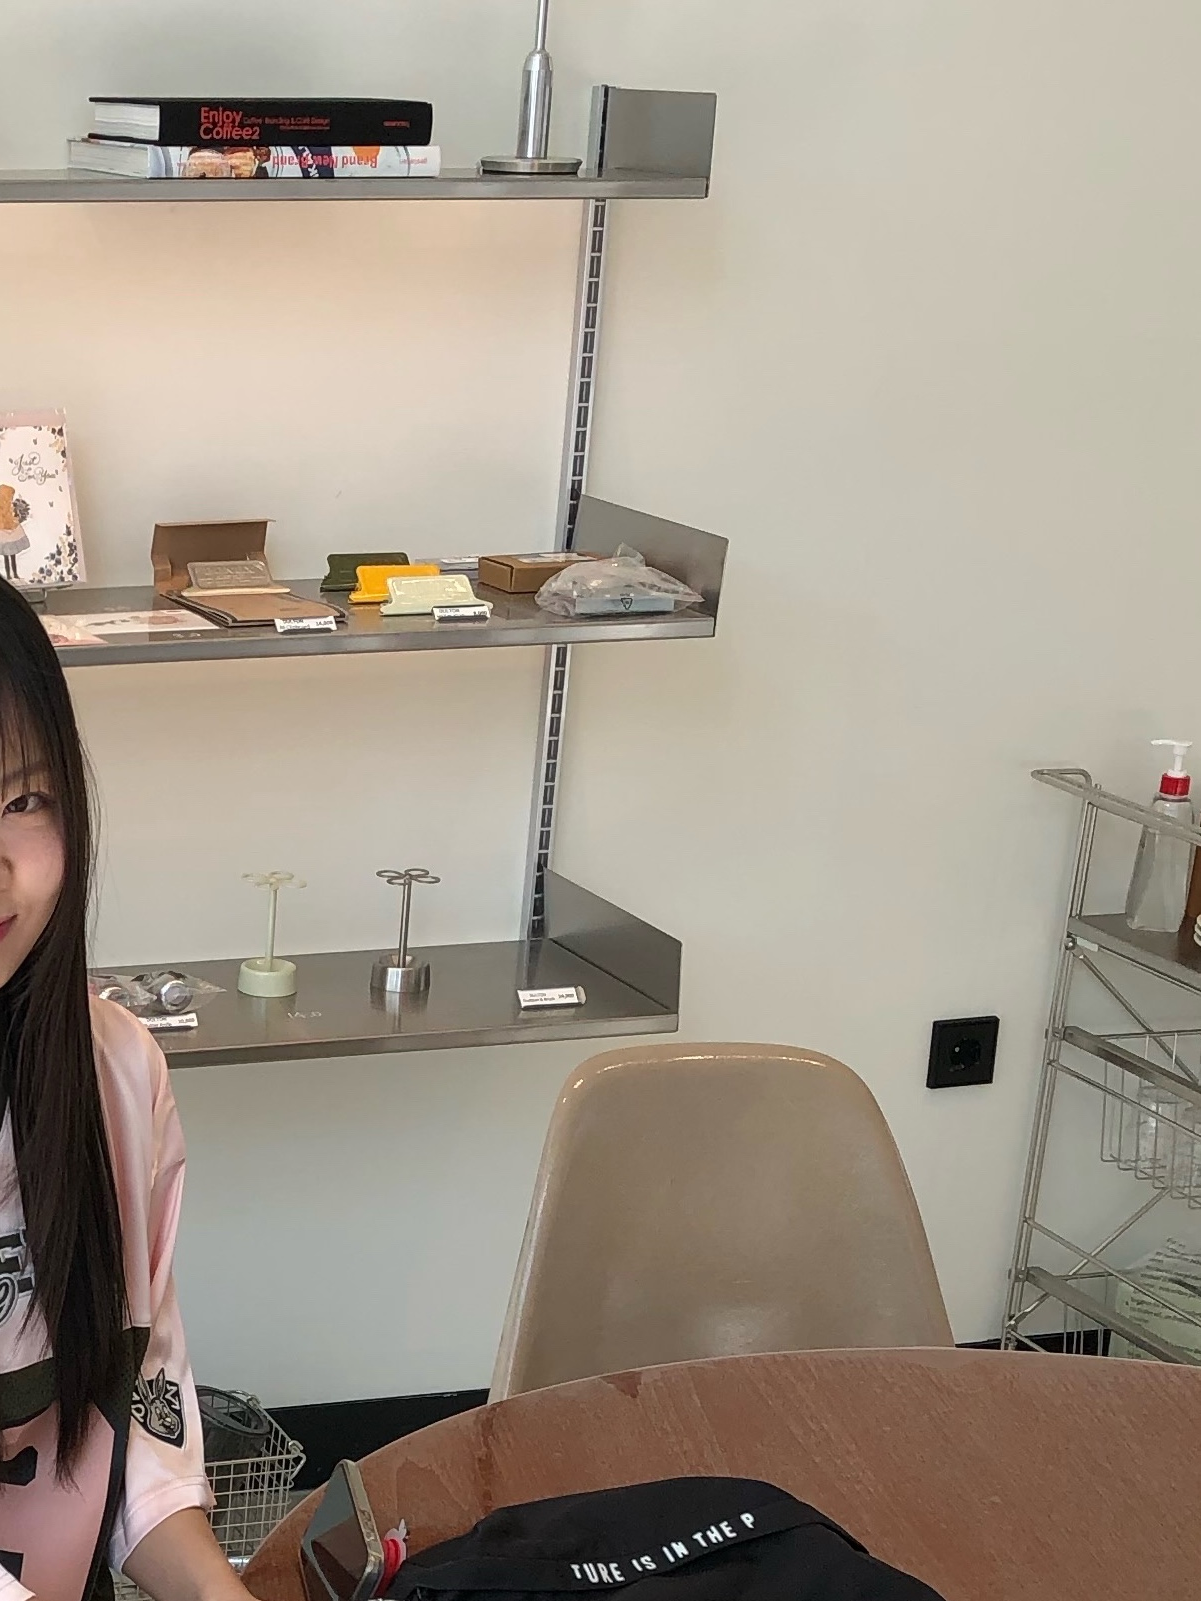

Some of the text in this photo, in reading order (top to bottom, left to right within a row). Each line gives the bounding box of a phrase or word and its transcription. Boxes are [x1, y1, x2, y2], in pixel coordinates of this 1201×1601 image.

[200, 107, 243, 126] Enjoy
[199, 122, 260, 140] Coffee2
[272, 153, 378, 169] Brand New Brand
[632, 1555, 656, 1572] IS
[662, 1541, 689, 1563] IN
[692, 1520, 737, 1548] THE
[740, 1512, 756, 1529] P
